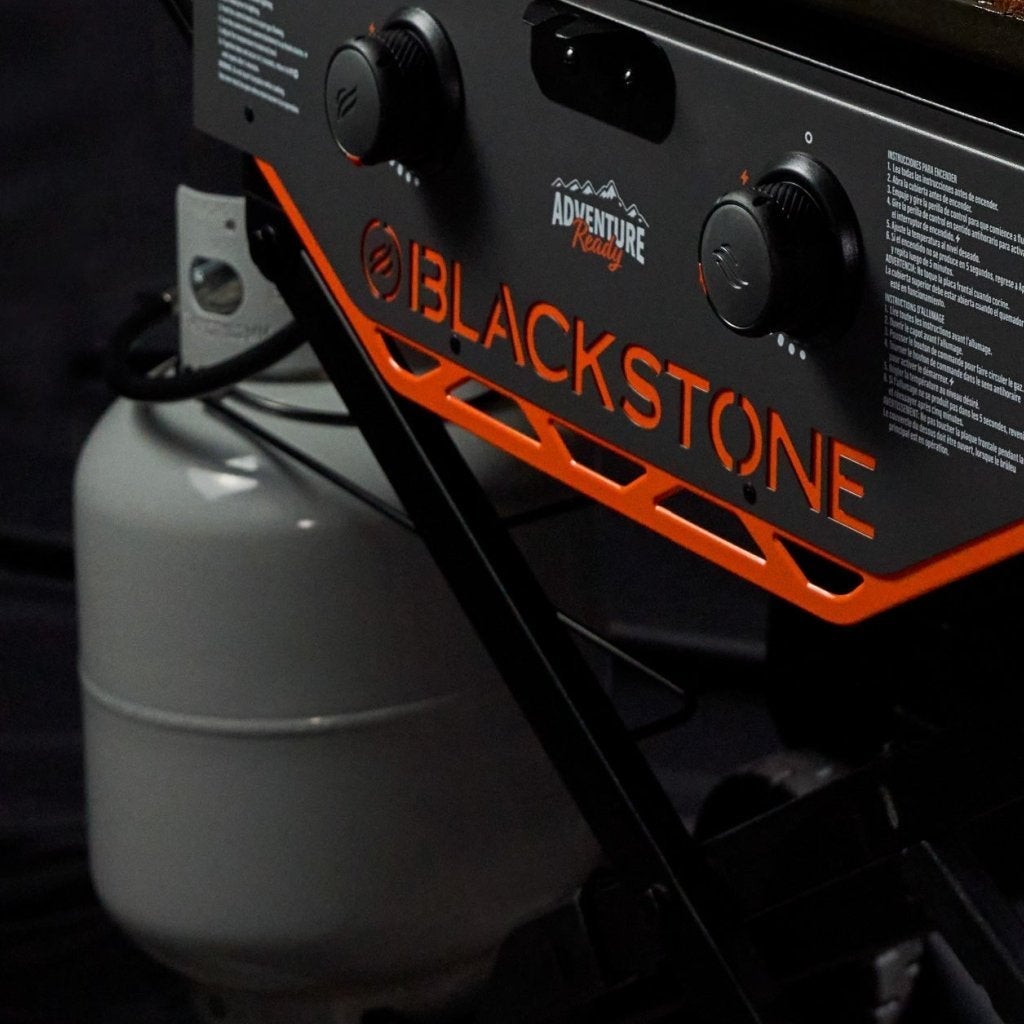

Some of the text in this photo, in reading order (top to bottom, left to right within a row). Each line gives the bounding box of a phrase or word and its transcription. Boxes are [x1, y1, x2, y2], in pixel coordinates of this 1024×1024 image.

[551, 191, 646, 266] ADVENTURE
[571, 217, 624, 272] Ready
[409, 242, 877, 539] BLACKSTONE
